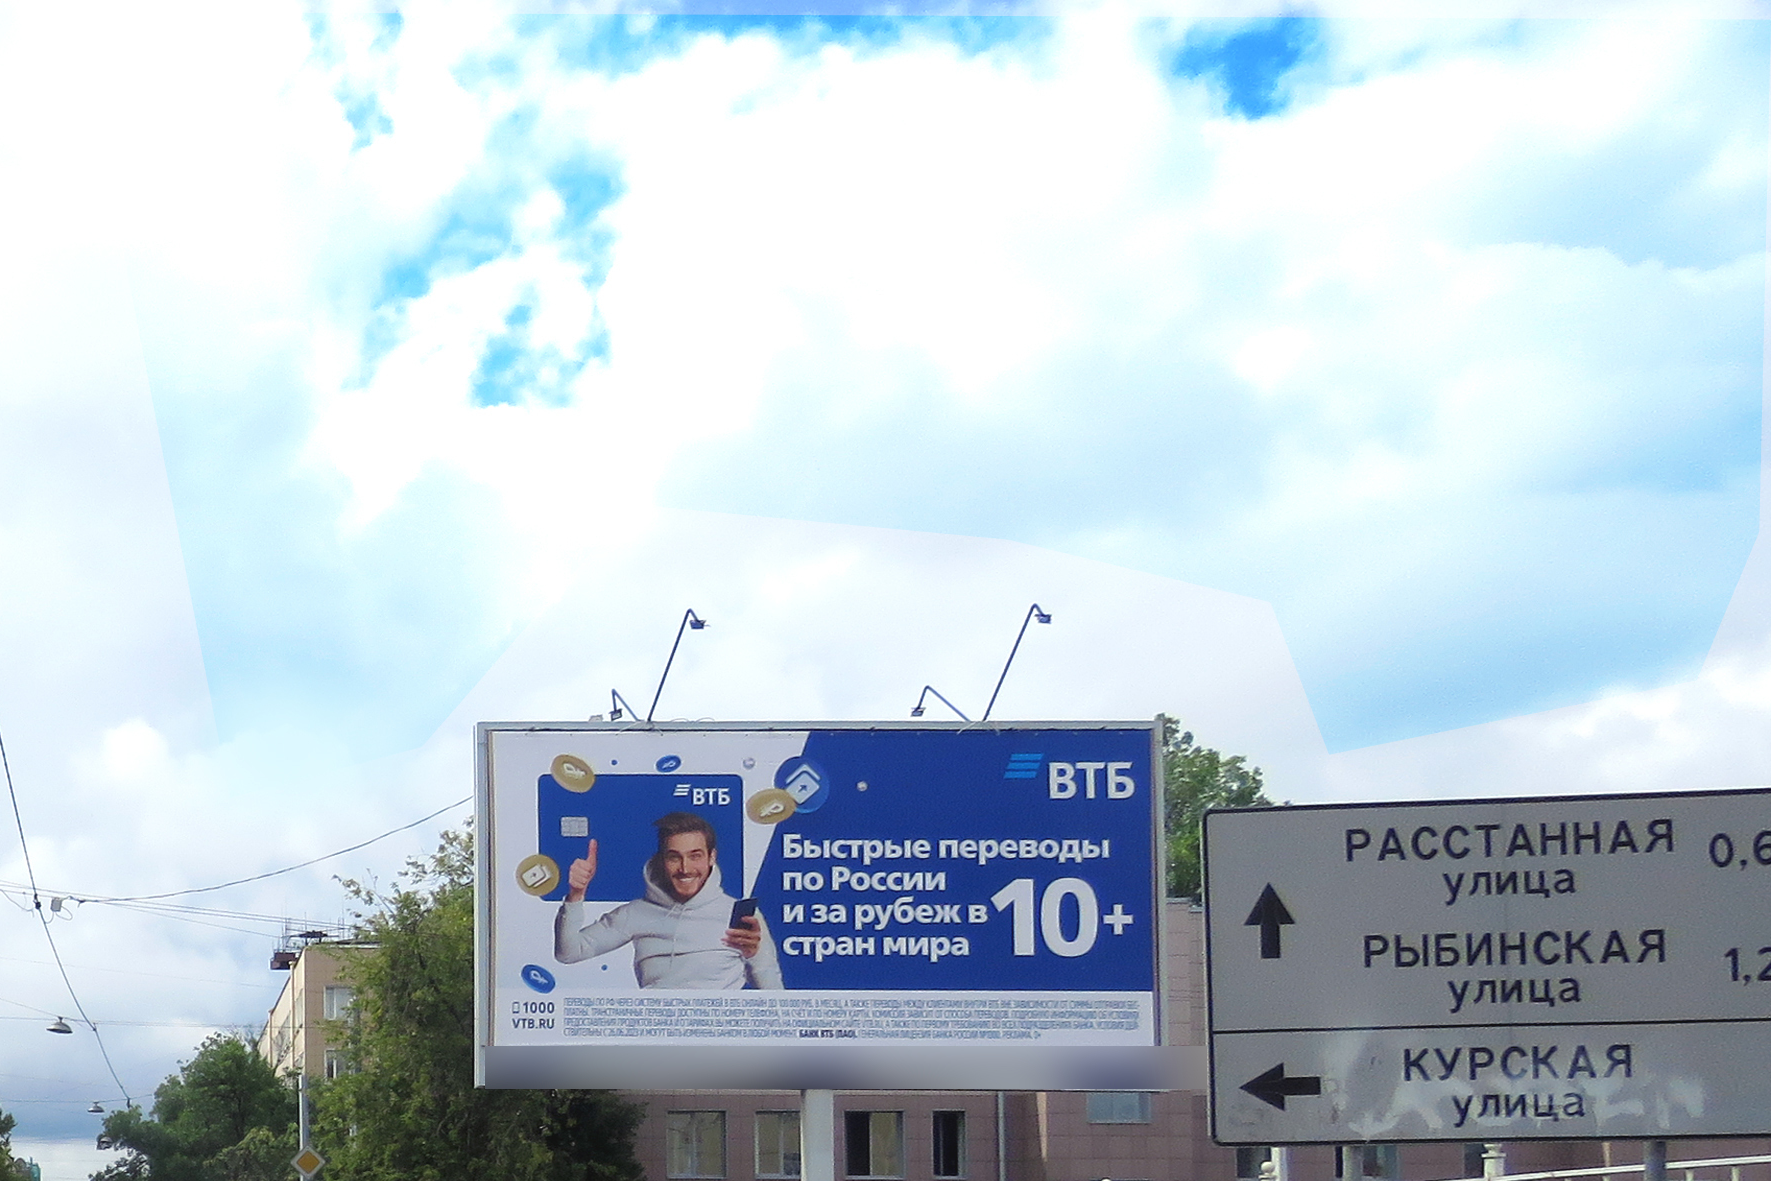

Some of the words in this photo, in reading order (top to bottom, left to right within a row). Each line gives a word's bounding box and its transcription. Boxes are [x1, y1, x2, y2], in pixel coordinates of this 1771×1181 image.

[693, 787, 731, 805] ВТБ
[1049, 761, 1135, 799] ВТБ
[783, 833, 931, 865] Быстрые
[939, 839, 1110, 866] переводы
[1345, 818, 1674, 862] РАССТАННАЯ
[783, 871, 824, 891] по
[832, 866, 946, 891] России
[1443, 868, 1577, 906] улица
[783, 904, 804, 923] и
[811, 904, 847, 924] за
[855, 896, 962, 931] рубеж
[969, 904, 989, 924] в
[783, 936, 875, 963] стран
[884, 936, 970, 963] мира
[1364, 928, 1666, 968] РЫБИНСКАЯ
[522, 1001, 555, 1014] 1000
[1448, 977, 1582, 1014] улица
[512, 1017, 555, 1030] VTB.RU
[1404, 1043, 1633, 1082] КУРСКАЯ
[1453, 1092, 1586, 1129] улица
